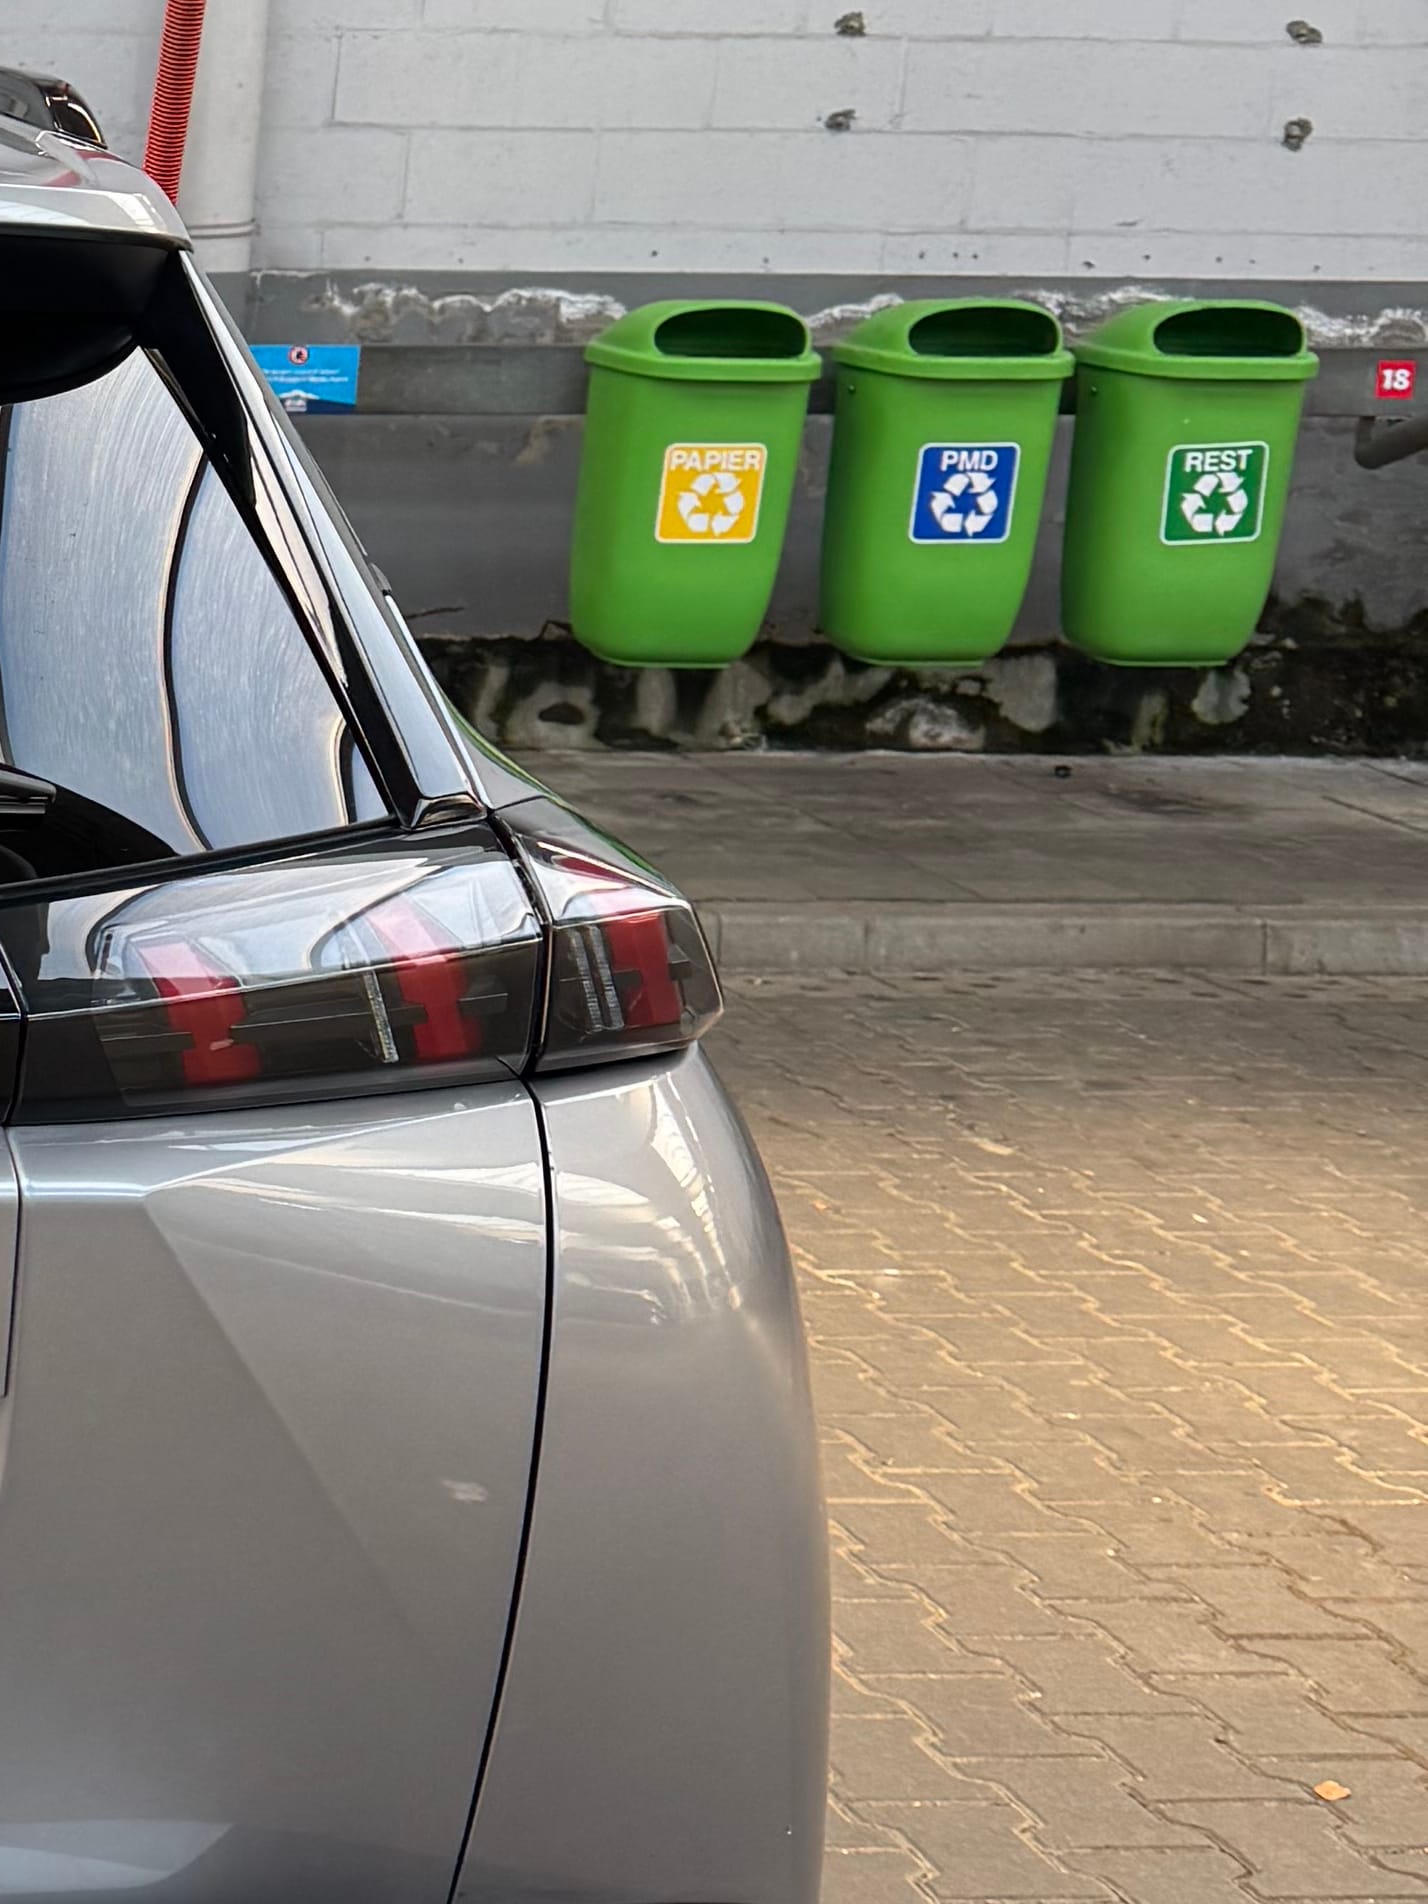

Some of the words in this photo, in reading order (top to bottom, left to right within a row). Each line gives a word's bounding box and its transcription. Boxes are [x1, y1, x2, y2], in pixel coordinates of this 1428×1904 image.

[1383, 368, 1411, 391] 18
[670, 449, 760, 473] PAPIER
[940, 450, 999, 472] PMD
[1184, 449, 1254, 473] REST
